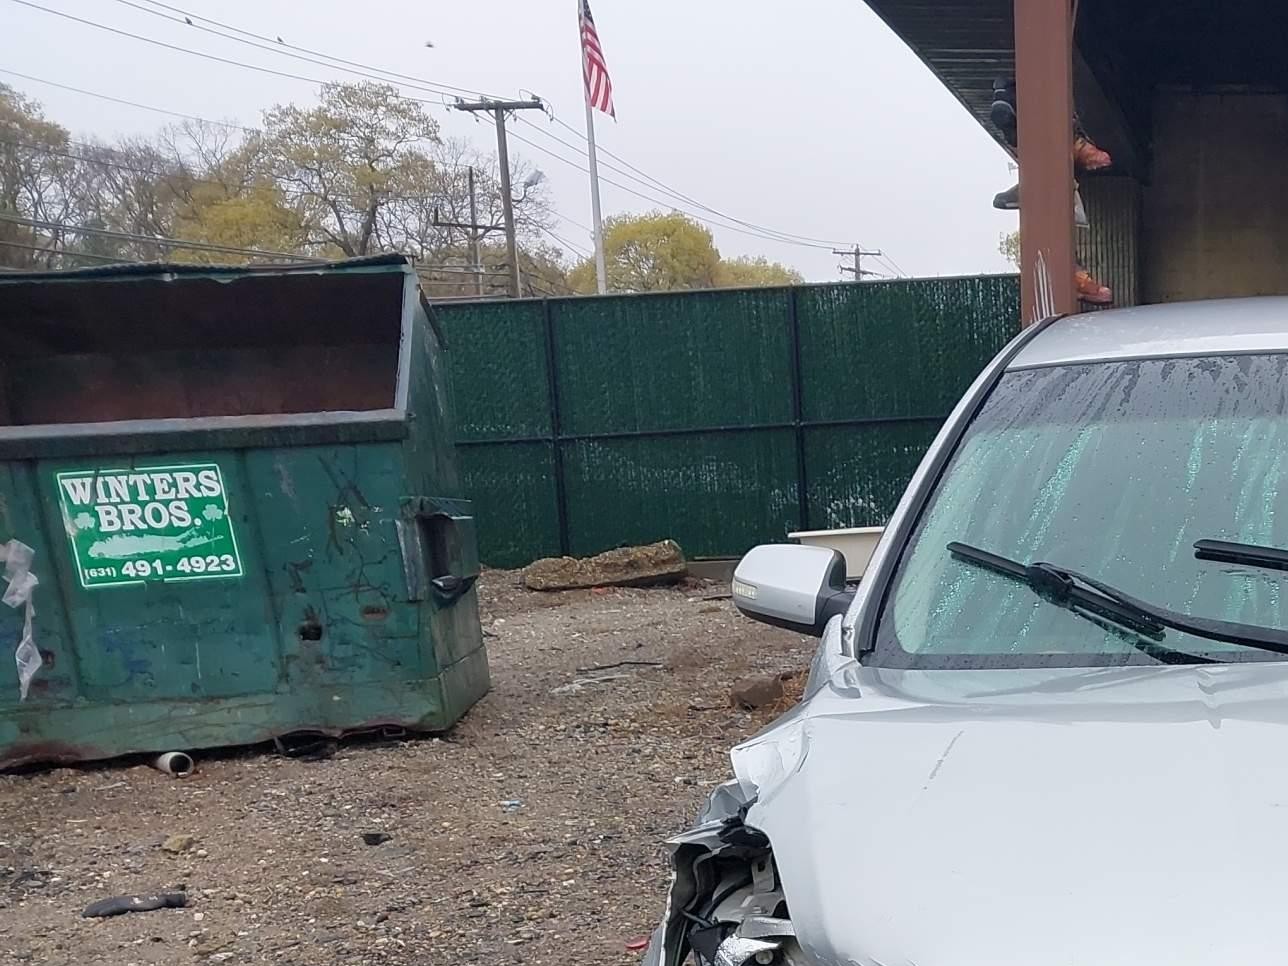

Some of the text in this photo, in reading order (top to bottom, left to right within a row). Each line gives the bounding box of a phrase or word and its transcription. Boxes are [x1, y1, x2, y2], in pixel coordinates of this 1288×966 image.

[61, 470, 221, 505] WINTERS
[95, 500, 202, 532] BROS.
[84, 566, 117, 579] (631)
